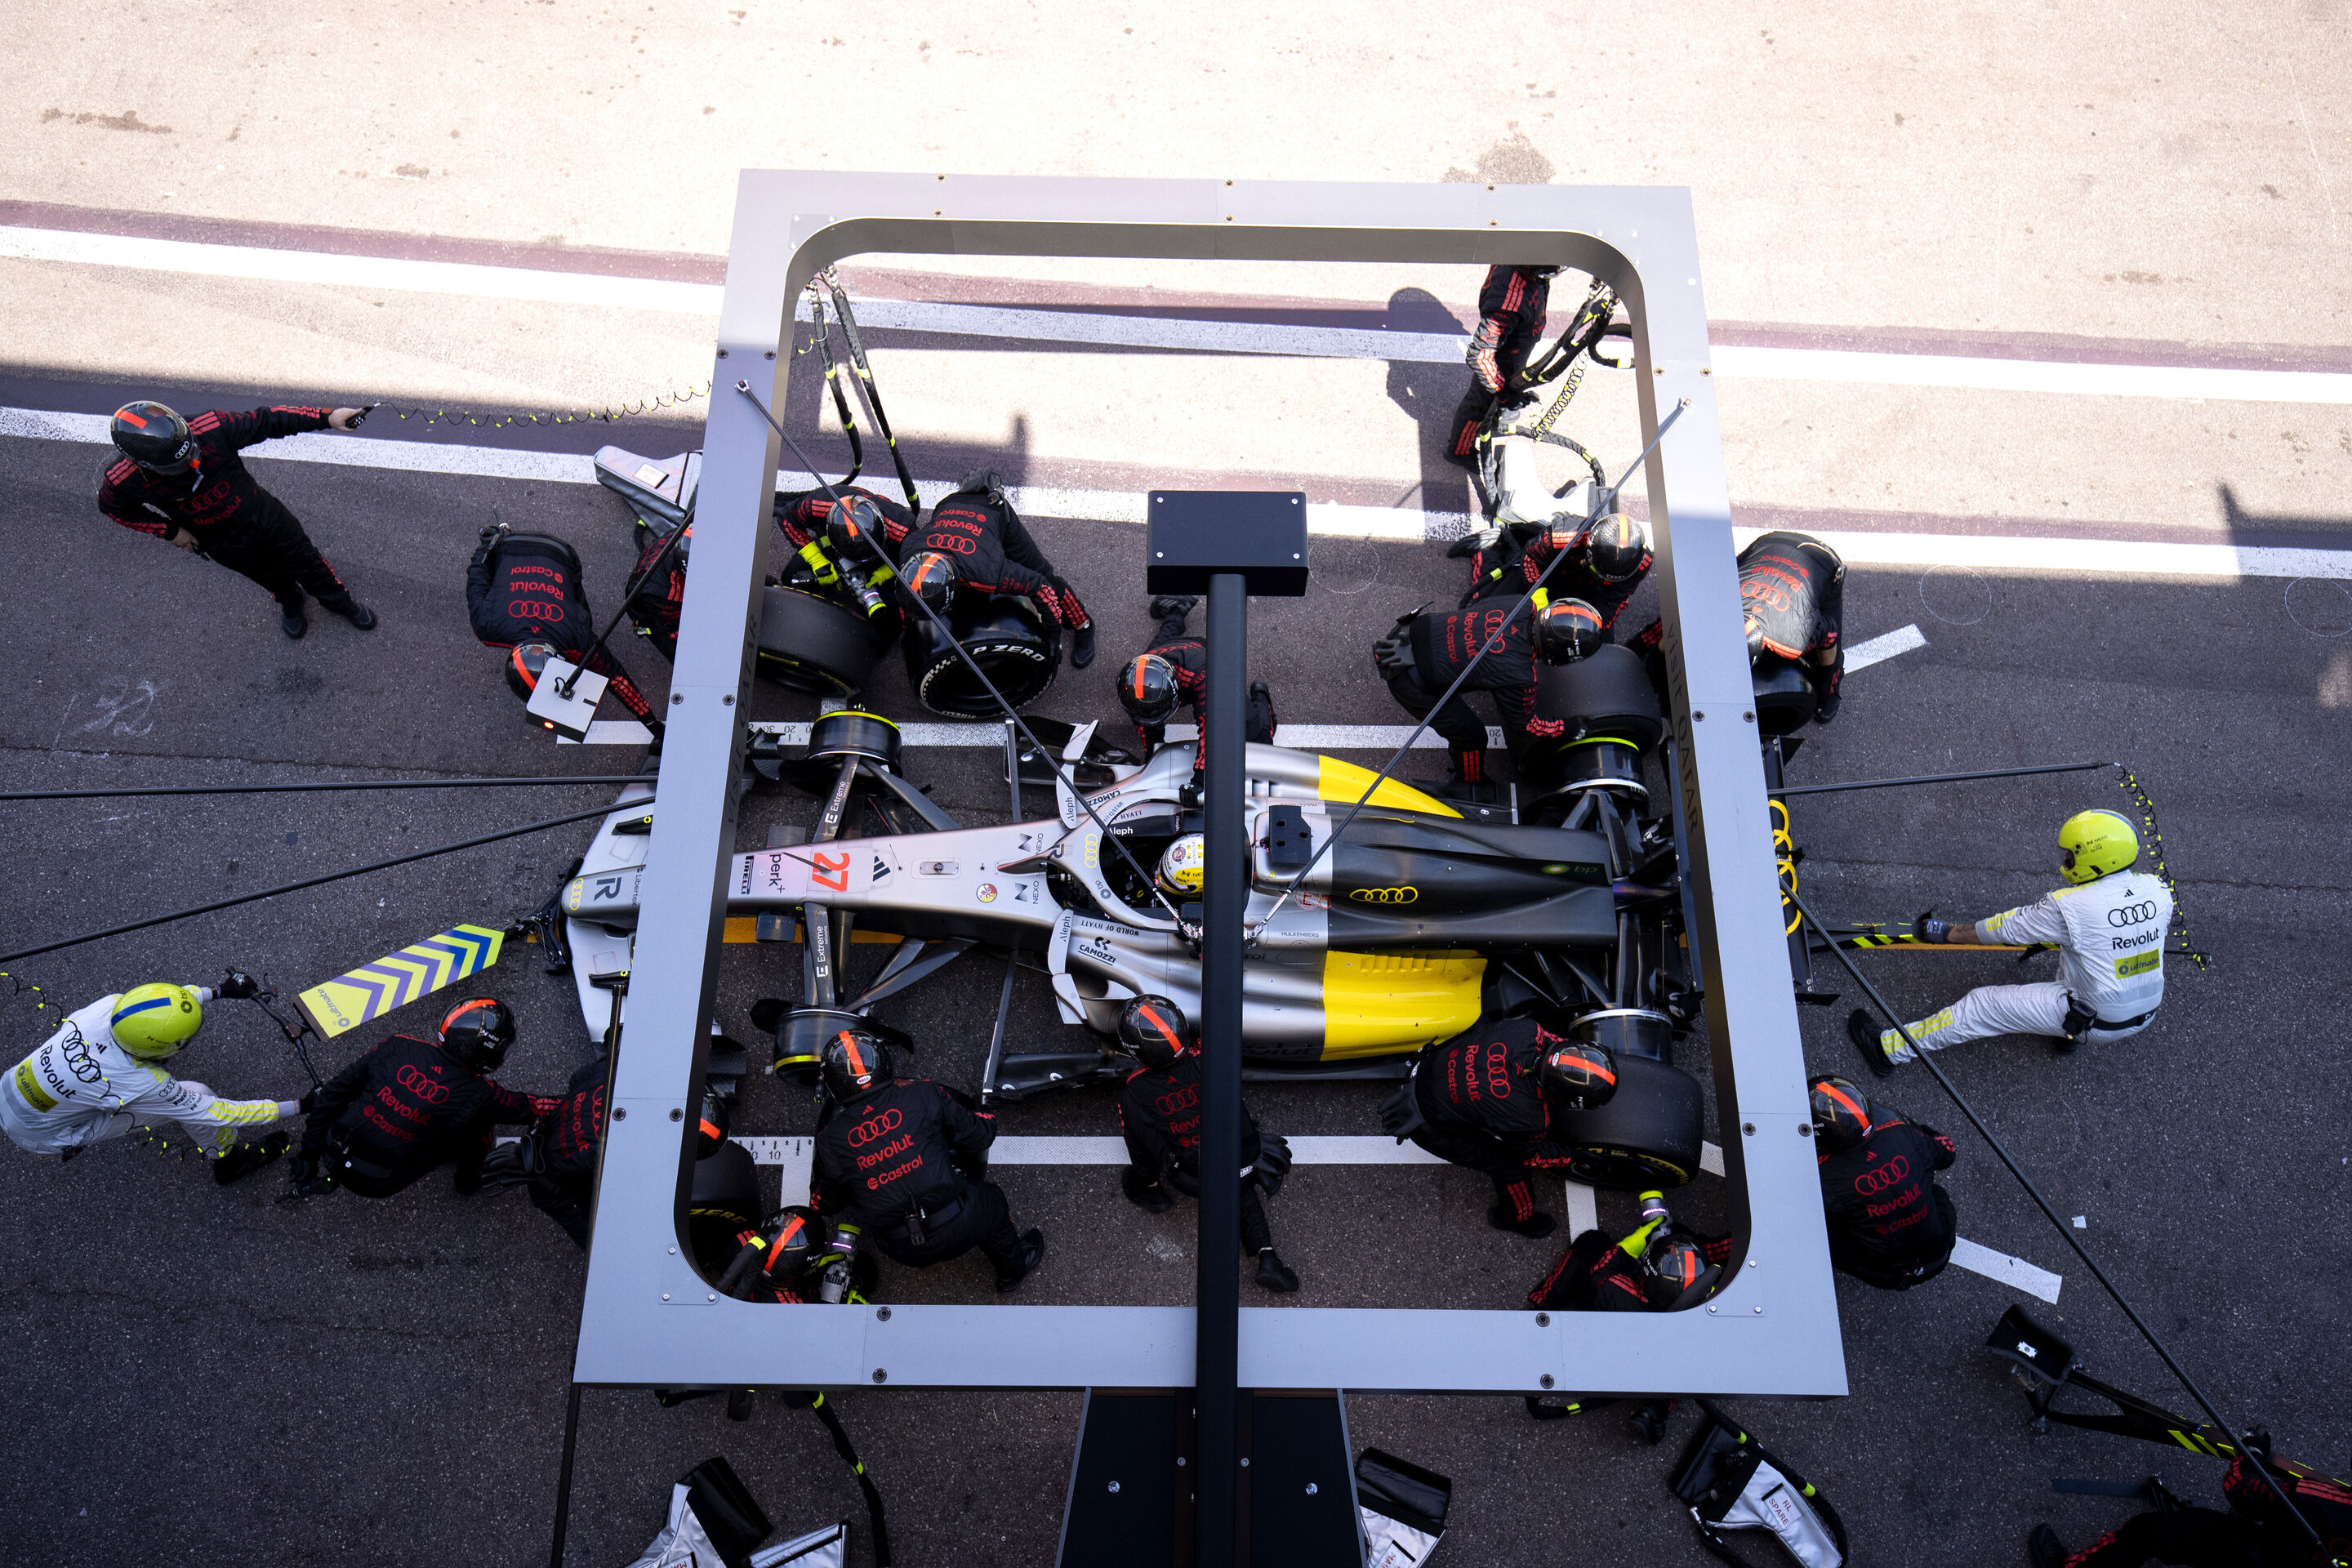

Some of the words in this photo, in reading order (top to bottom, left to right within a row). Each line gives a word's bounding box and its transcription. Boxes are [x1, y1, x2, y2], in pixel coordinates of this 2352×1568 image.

[194, 495, 242, 525] Revolut
[933, 519, 982, 537] Revolut
[510, 566, 555, 577] Castrol
[1759, 555, 1800, 570] Castrol
[510, 581, 564, 600] Revolut
[1751, 565, 1803, 593] Revolut
[1446, 625, 1460, 663] Castrol
[1463, 611, 1479, 658] Revolut
[972, 645, 987, 656] P
[991, 644, 1046, 662] ZERO
[1677, 715, 1698, 833] QATAR
[831, 781, 846, 811] Extreme
[1086, 790, 1120, 806] CAMOZZ
[1120, 810, 1143, 819] HYATT
[1036, 833, 1044, 855] NEXO
[741, 855, 755, 895] PIRELLI
[812, 853, 850, 892] 27
[1575, 866, 1598, 874] bp
[632, 874, 642, 906] Libertex
[1095, 880, 1103, 890] bp
[1059, 916, 1071, 942] Aleph
[1080, 920, 1103, 929] HYATT
[1116, 927, 1139, 937] WORLD
[817, 925, 826, 963] Extreme
[2112, 928, 2159, 950] Revolut
[1079, 944, 1116, 964] CAMOZZI
[2130, 956, 2158, 972] ultimate
[317, 987, 342, 1019] ultimate
[39, 1045, 77, 1100] Revolut
[1447, 1059, 1461, 1104] Castrol
[1464, 1044, 1482, 1102] Revolut
[20, 1077, 50, 1110] ultimate
[376, 1085, 432, 1125] Revolut
[572, 1091, 590, 1153] Revolut
[1169, 1115, 1201, 1134] Revo
[769, 1151, 781, 1160] 10
[856, 1134, 915, 1171] Revolut
[878, 1154, 924, 1184] Castrol
[1866, 1183, 1922, 1218] Revolut
[1888, 1204, 1928, 1232] Castrol
[1768, 1498, 1790, 1526] SPARE
[1783, 1499, 1792, 1512] RL
